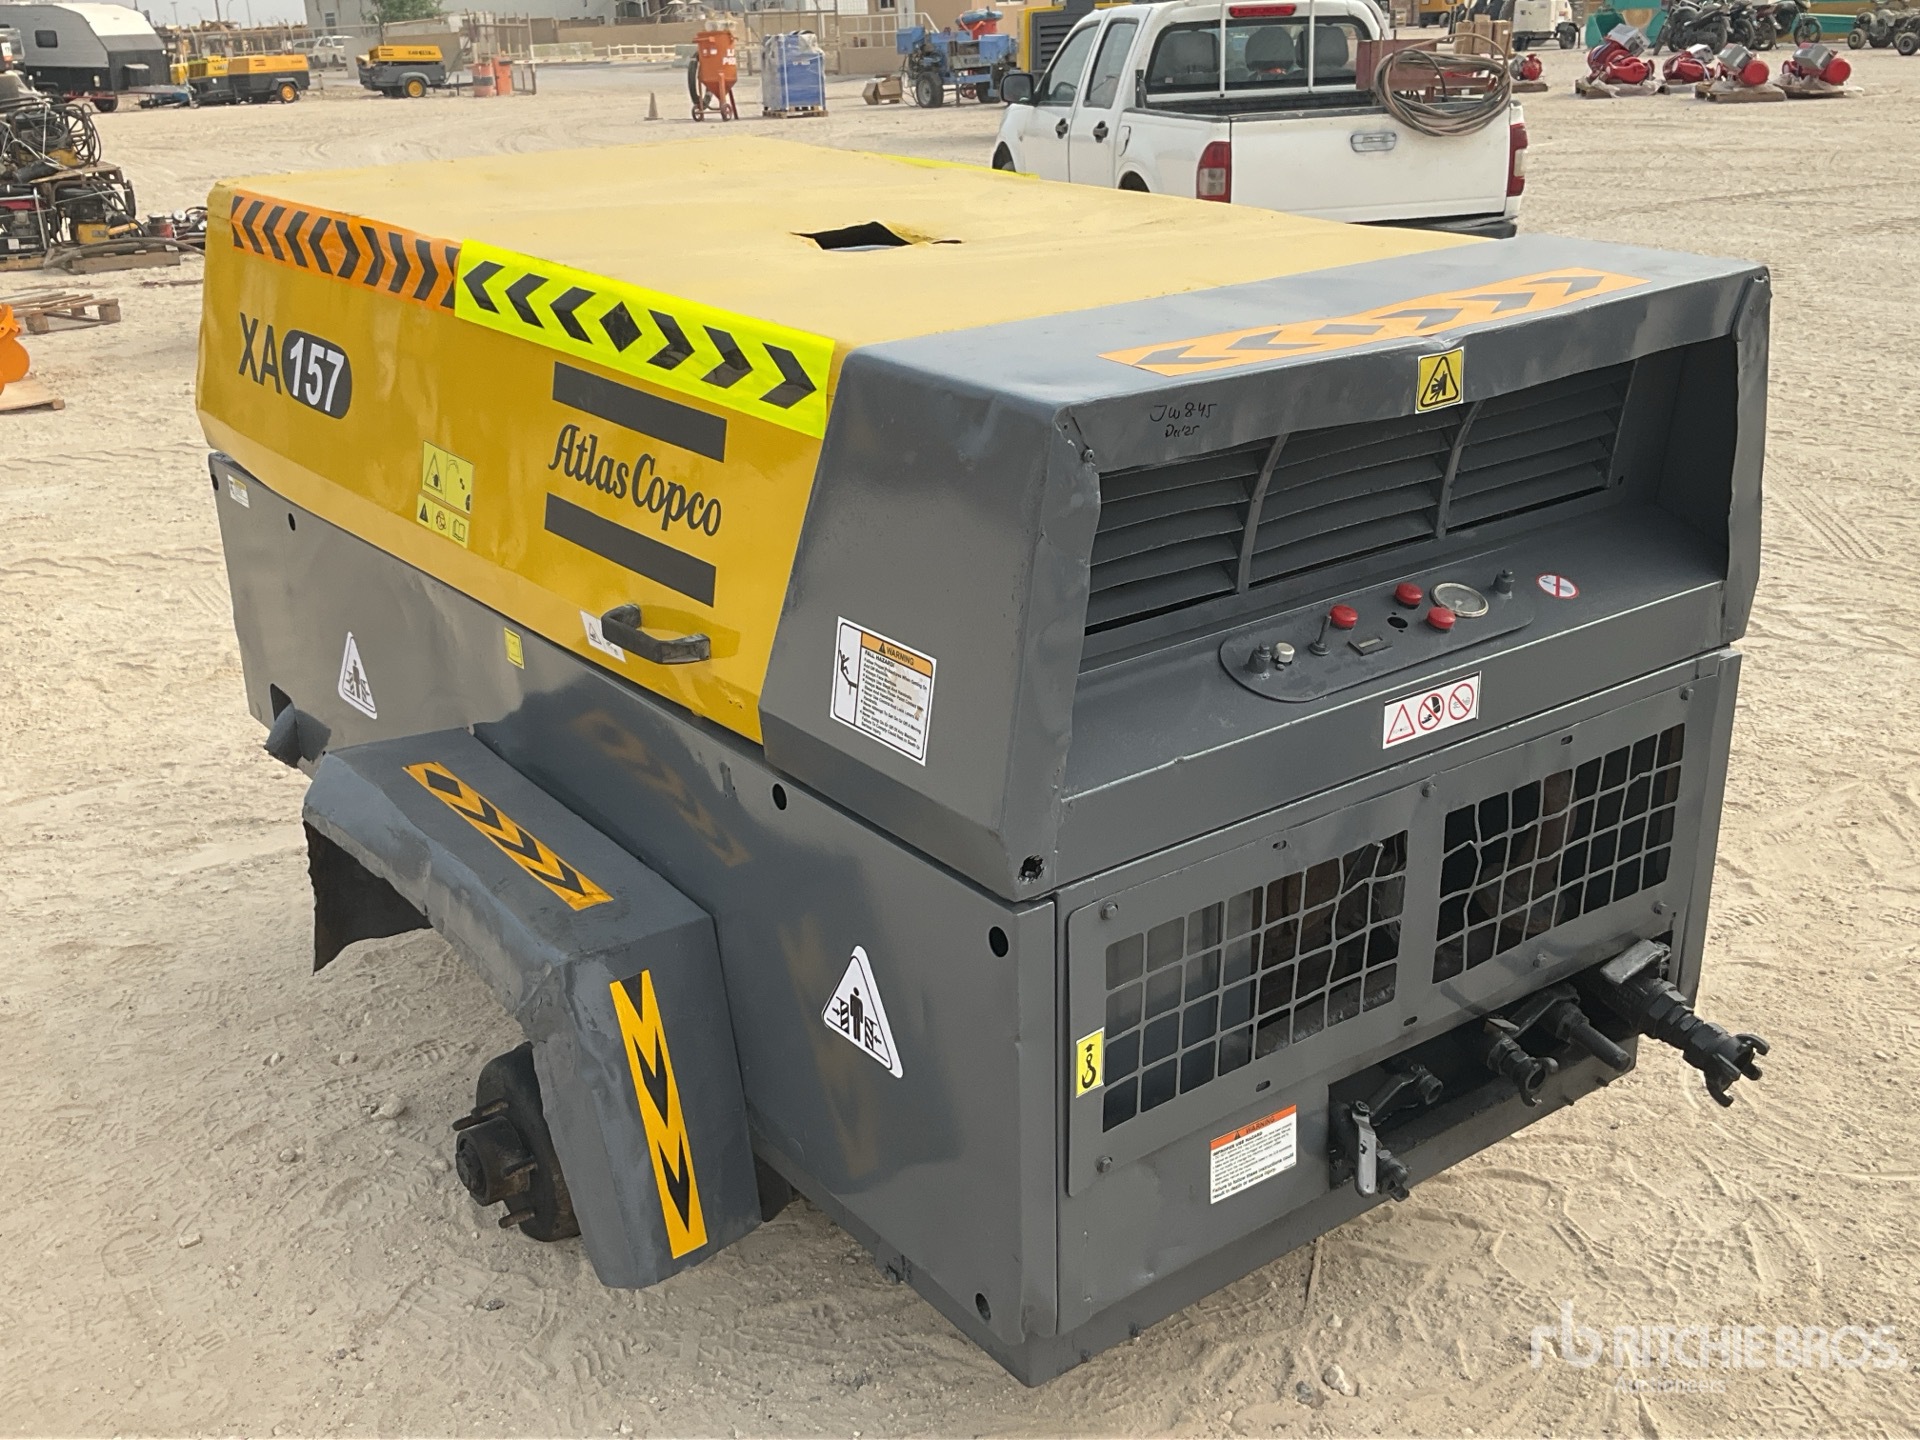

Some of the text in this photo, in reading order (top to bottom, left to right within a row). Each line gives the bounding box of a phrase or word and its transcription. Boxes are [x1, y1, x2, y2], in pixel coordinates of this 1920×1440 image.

[238, 311, 345, 413] XA 157
[547, 423, 722, 537] Atlas Copco
[886, 646, 915, 666] WARNING
